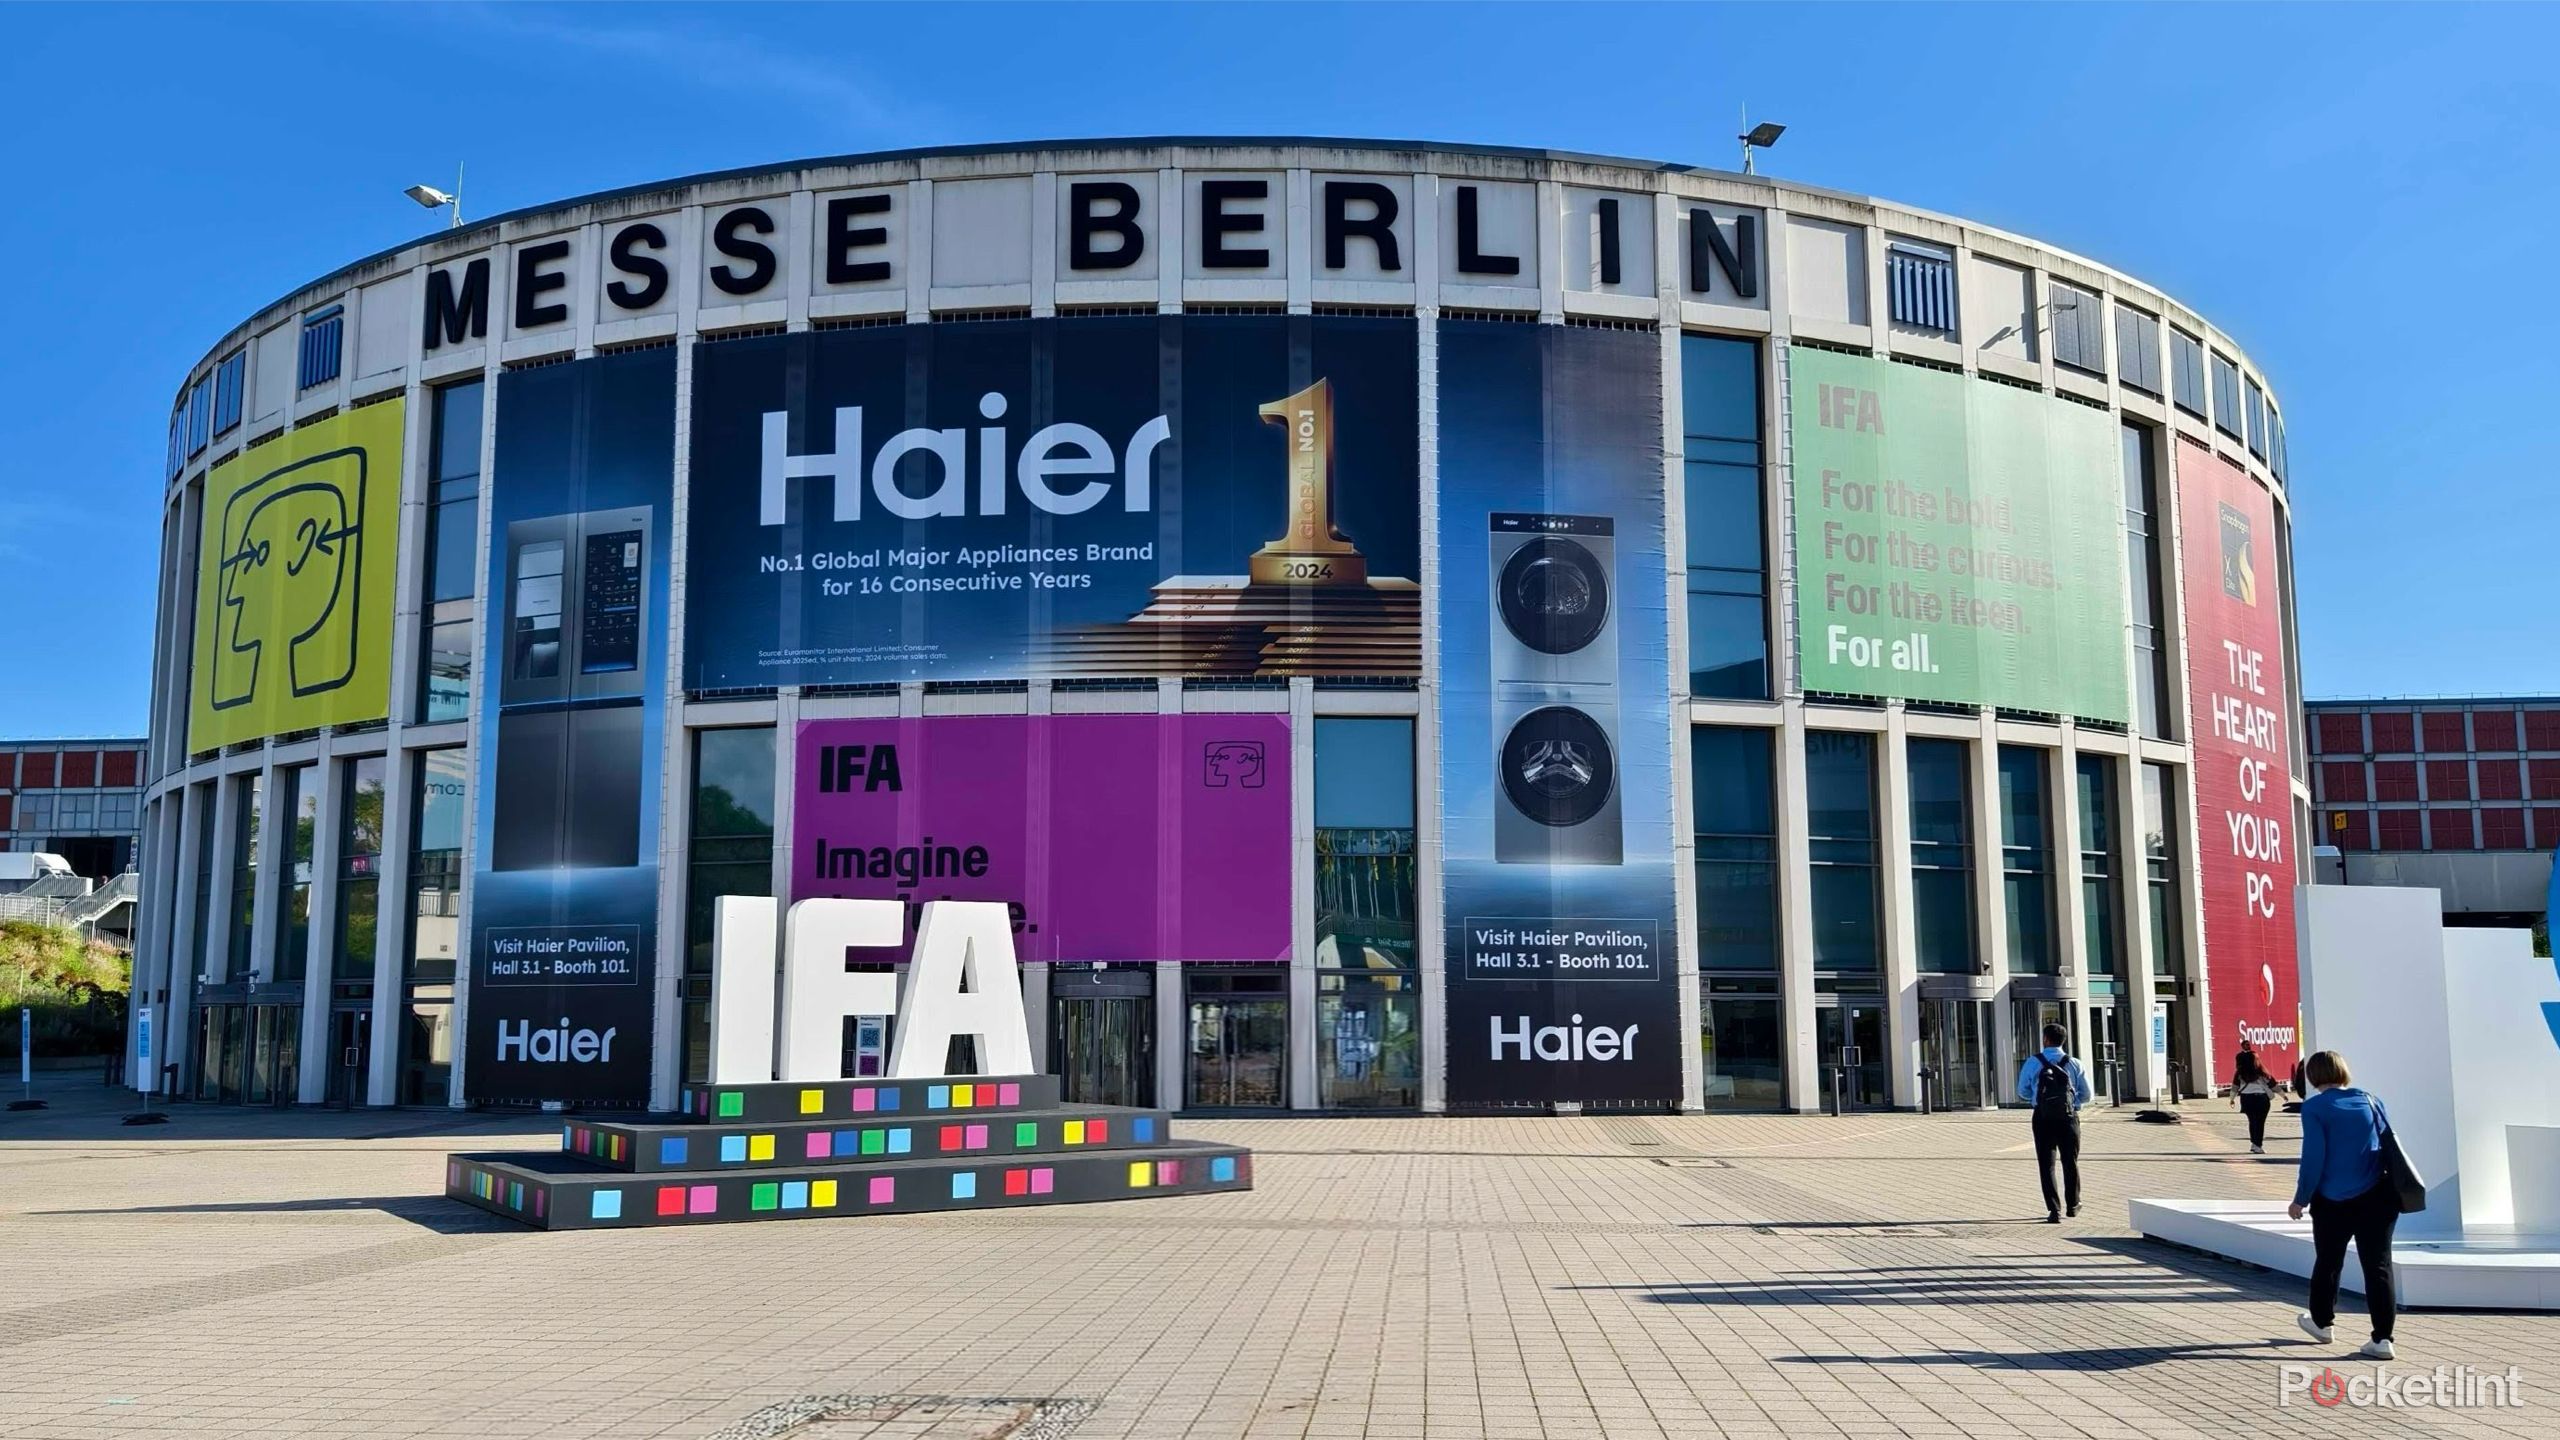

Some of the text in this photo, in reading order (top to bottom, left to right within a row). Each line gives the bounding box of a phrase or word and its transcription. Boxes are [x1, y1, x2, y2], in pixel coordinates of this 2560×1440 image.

[424, 179, 1758, 350] MESSE BERLIN
[1818, 383, 1885, 435] IFA
[760, 391, 1171, 526] Haier
[1299, 410, 1315, 539] GLOBAL NO.1
[1822, 469, 2017, 536] For the bold.
[760, 541, 1153, 573] No.1 Global Major Appliances Brand
[1283, 563, 1333, 579] 2024
[1824, 521, 2062, 592] For the curious.
[822, 570, 1092, 597] for 16 Consecutive Years
[1826, 573, 2031, 635] For the keen.
[784, 648, 825, 656] Euromonitor
[828, 645, 871, 654] International
[1828, 624, 1940, 674] For all.
[2223, 639, 2265, 696] THE
[2212, 692, 2277, 753] HEART
[819, 744, 902, 793] IFA
[2239, 757, 2266, 804] OF
[2226, 809, 2282, 864] YOUR
[816, 836, 989, 888] Imagine
[2246, 871, 2275, 919] PC
[494, 936, 630, 955] Visit Haier Pavilion,
[1476, 929, 1648, 950] Visit Haier Pavilion,
[1476, 952, 1511, 968] Hall
[1517, 953, 1541, 968] 3.1
[1559, 953, 1610, 969] Booth
[1615, 954, 1649, 969] 101.
[492, 960, 518, 975] Hall
[522, 960, 540, 975] 3.1
[554, 959, 596, 974] Booth
[601, 959, 630, 974] 101.
[708, 894, 1035, 1082] IFA
[497, 1016, 616, 1063] Haier
[1490, 1013, 1639, 1061] Haier
[2238, 1019, 2296, 1052] Snapdragon
